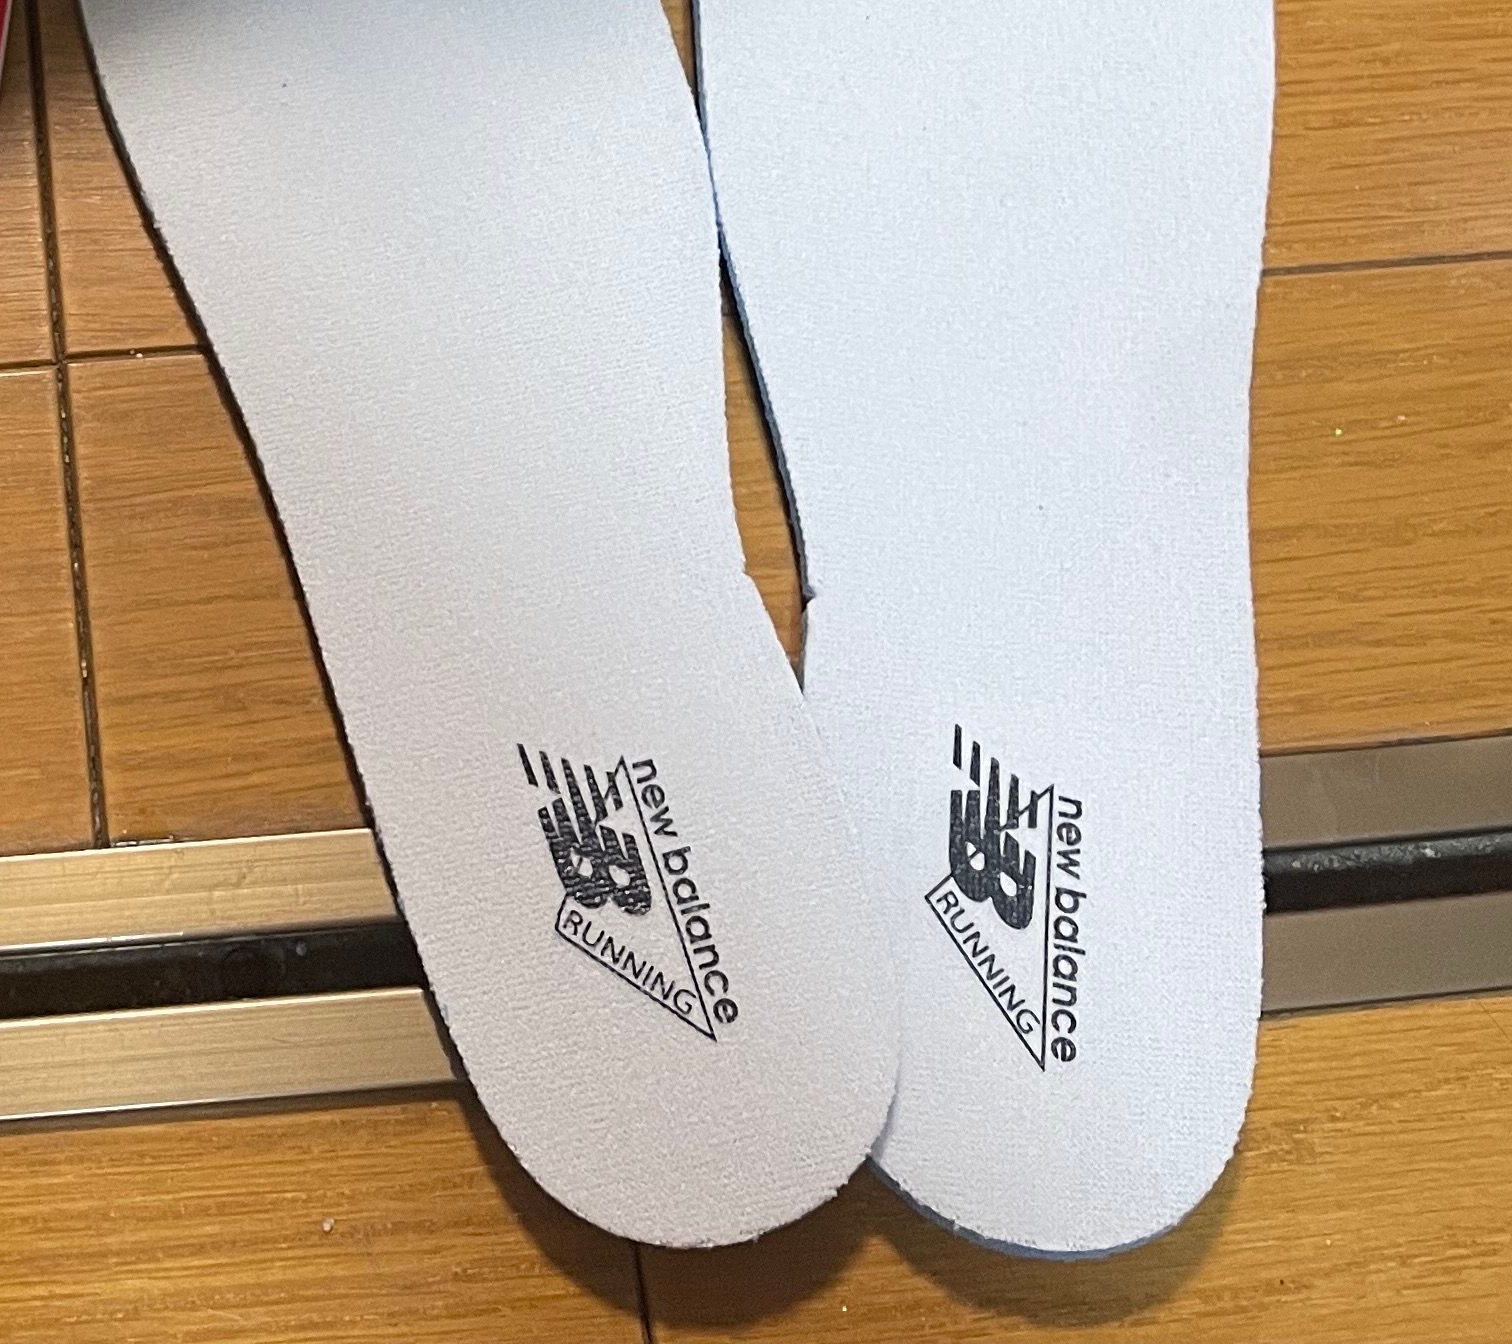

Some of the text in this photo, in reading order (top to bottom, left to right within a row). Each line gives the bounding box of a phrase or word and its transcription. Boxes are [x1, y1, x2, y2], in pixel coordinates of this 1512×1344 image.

[561, 909, 698, 1016] RUNNING
[631, 758, 740, 1025] new balance
[935, 889, 1041, 1035] RUNNING
[1050, 795, 1088, 1064] new balance
